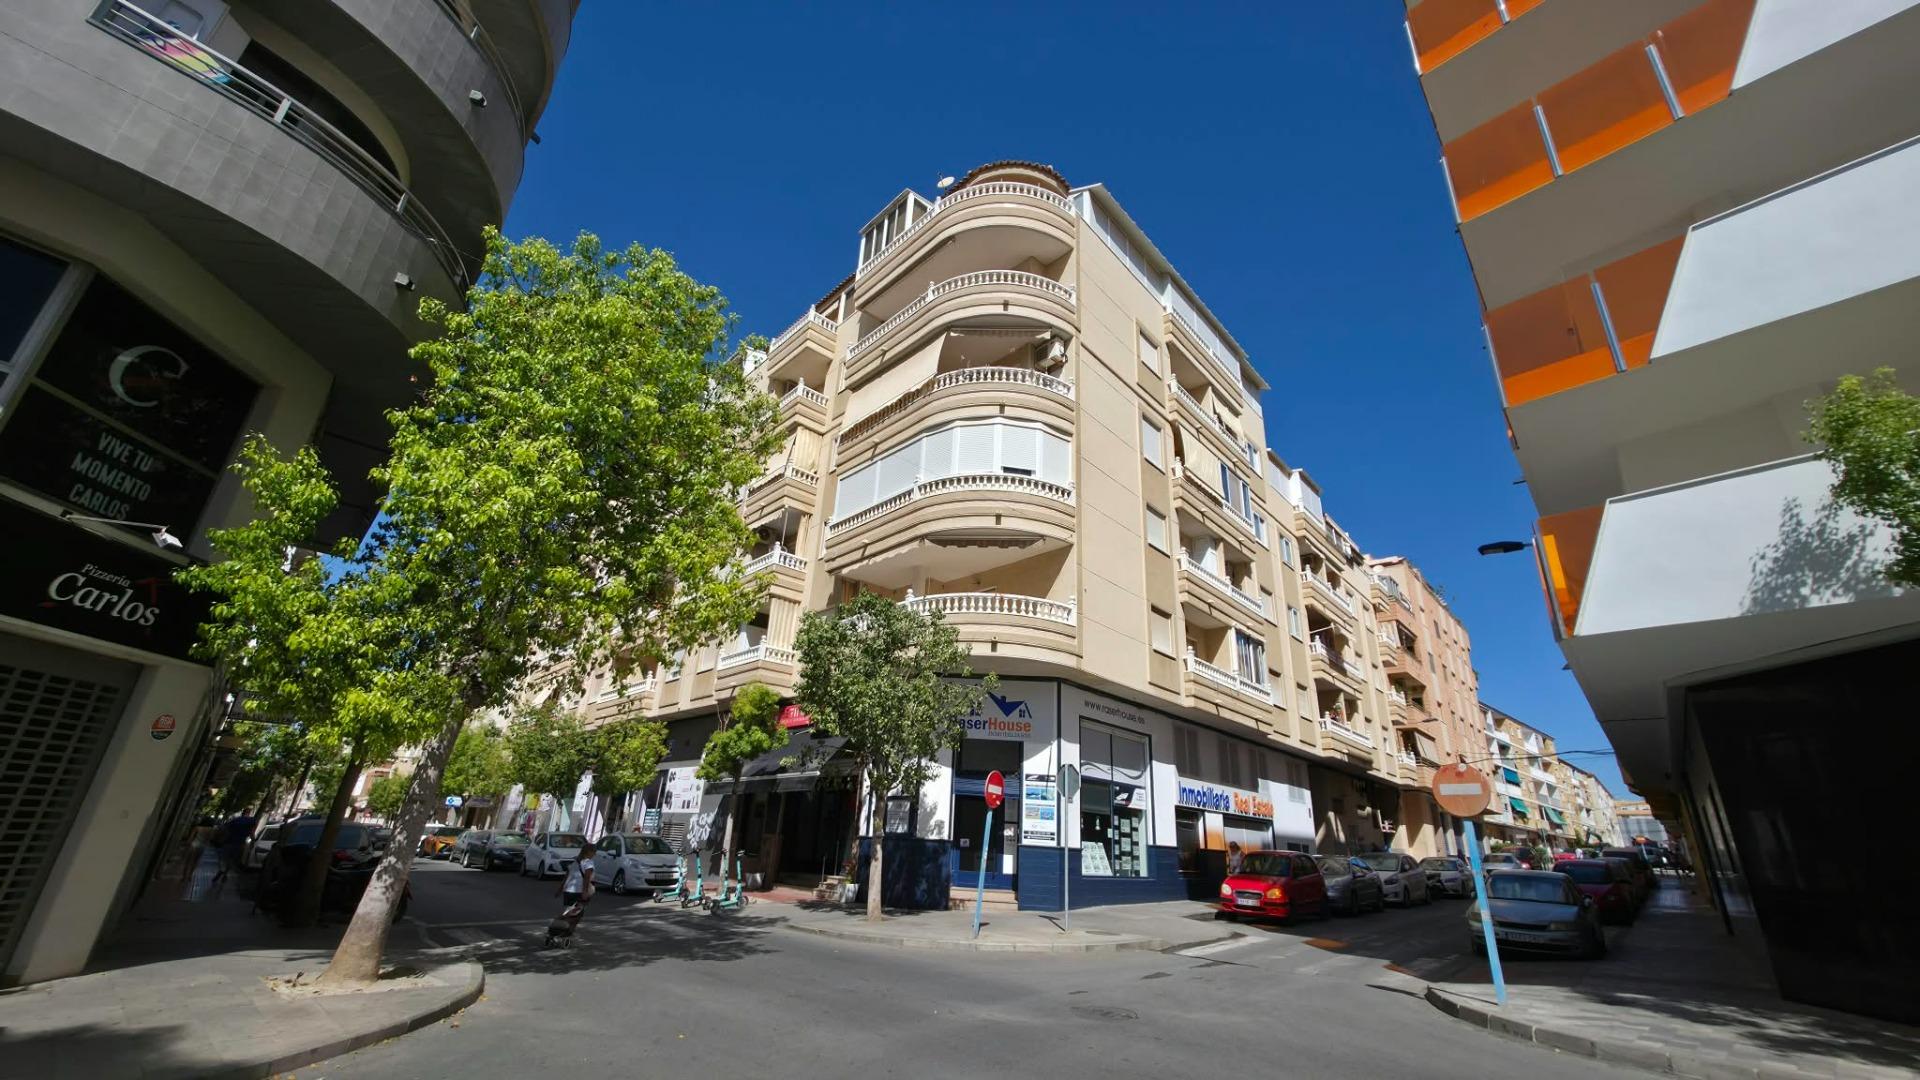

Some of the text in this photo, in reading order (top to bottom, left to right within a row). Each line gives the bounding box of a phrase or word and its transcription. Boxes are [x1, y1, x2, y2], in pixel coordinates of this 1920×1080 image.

[98, 432, 154, 472] VIVE TU
[70, 451, 151, 502] MOMENTO
[69, 483, 130, 521] CARLOS
[81, 563, 131, 587] Pizzeria
[48, 572, 160, 626] Carlos
[957, 717, 1031, 732] aserHouse
[1178, 780, 1230, 812] Inmobiliaria
